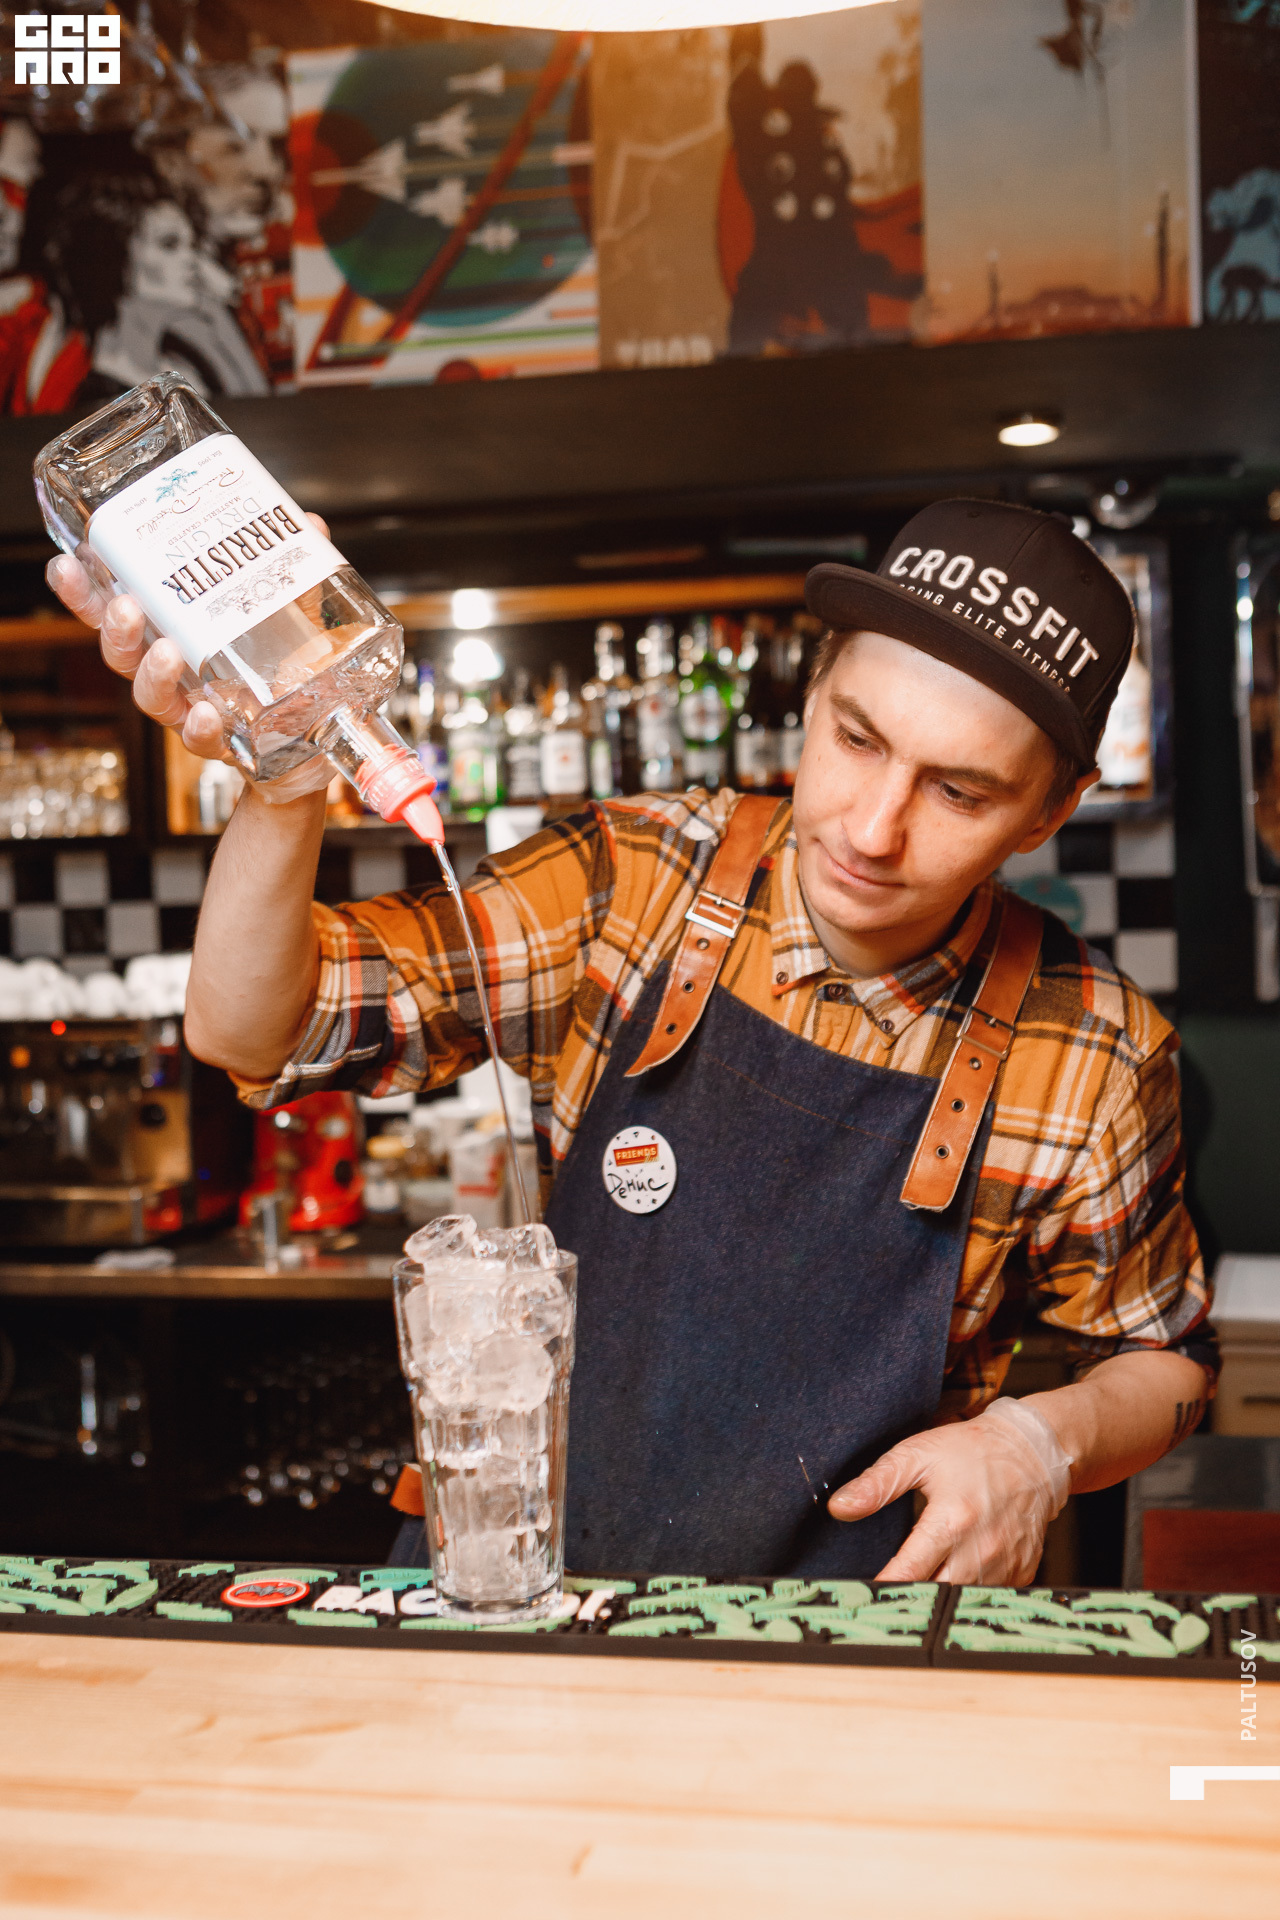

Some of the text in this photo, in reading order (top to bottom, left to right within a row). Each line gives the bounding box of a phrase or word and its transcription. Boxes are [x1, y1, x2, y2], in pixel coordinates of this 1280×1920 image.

[167, 495, 241, 545] MASTERLY CRAFTED
[215, 496, 262, 534] DRY
[161, 504, 303, 604] BARRISTER
[164, 529, 210, 565] GIN
[889, 547, 1099, 677] CROSSFIT
[952, 602, 1007, 639] ELITE
[616, 1147, 657, 1160] FRIENDS
